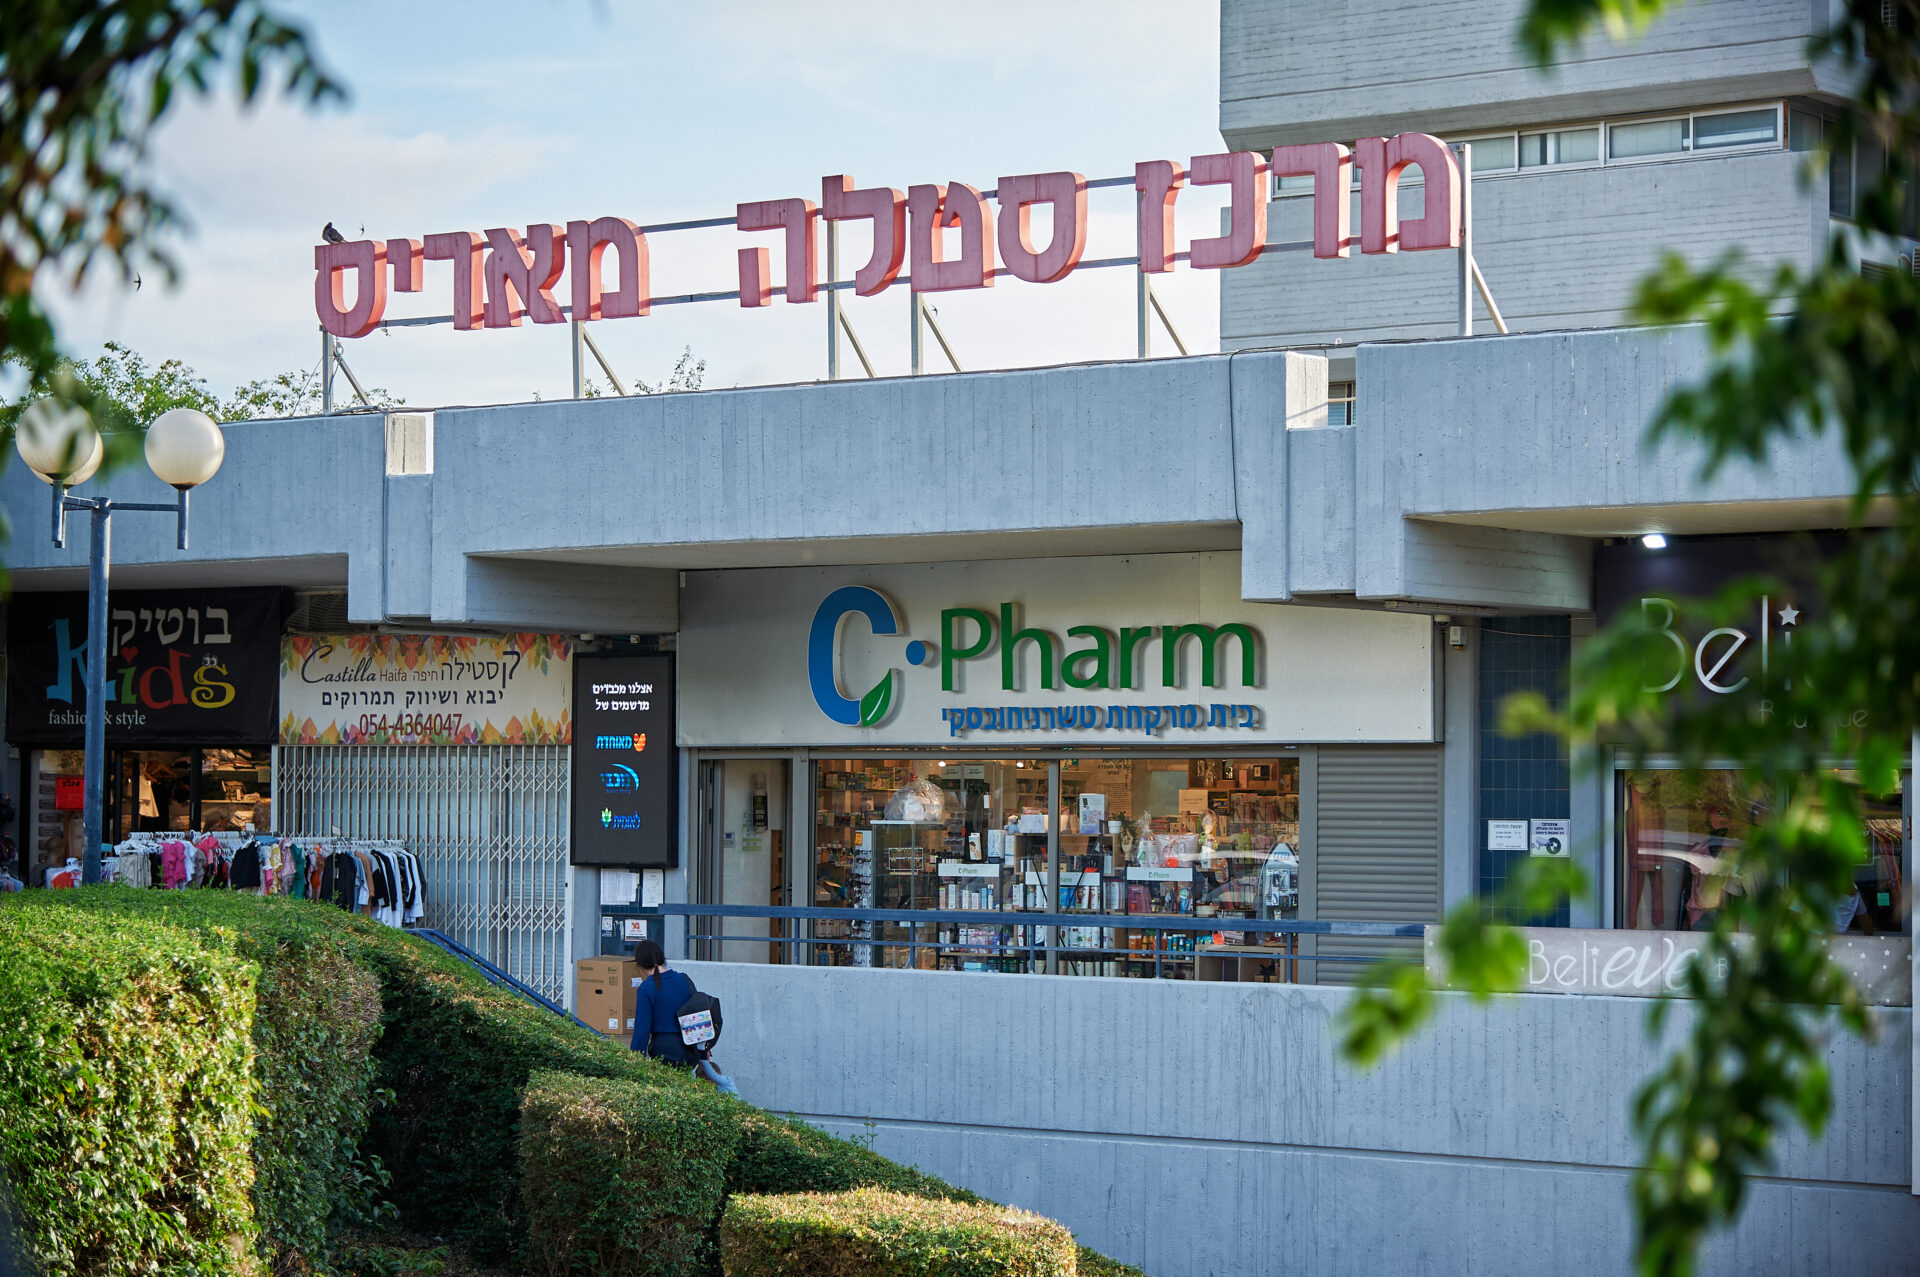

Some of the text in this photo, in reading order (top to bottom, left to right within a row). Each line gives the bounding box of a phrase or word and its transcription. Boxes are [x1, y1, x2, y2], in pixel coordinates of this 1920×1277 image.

[315, 132, 1461, 338] מרכז סטלה מאריס
[112, 606, 232, 657] בוטיק
[46, 617, 236, 709] Kids
[301, 645, 407, 683] Castilla Haifa
[413, 651, 521, 688] קסטילה חיפה
[322, 689, 504, 709] יבוא ושיווק תמרוקים
[592, 681, 653, 695] אצלנו מכבדים
[595, 698, 650, 711] מרשמים של
[48, 709, 88, 725] fashio
[115, 710, 146, 729] style
[359, 713, 463, 736] 054-4364047
[942, 704, 1255, 737] בית מרקחת טשרניחובסקי
[596, 735, 633, 750] מאוחדת
[613, 811, 641, 830] לאומית
[1529, 938, 1700, 991] Believe
